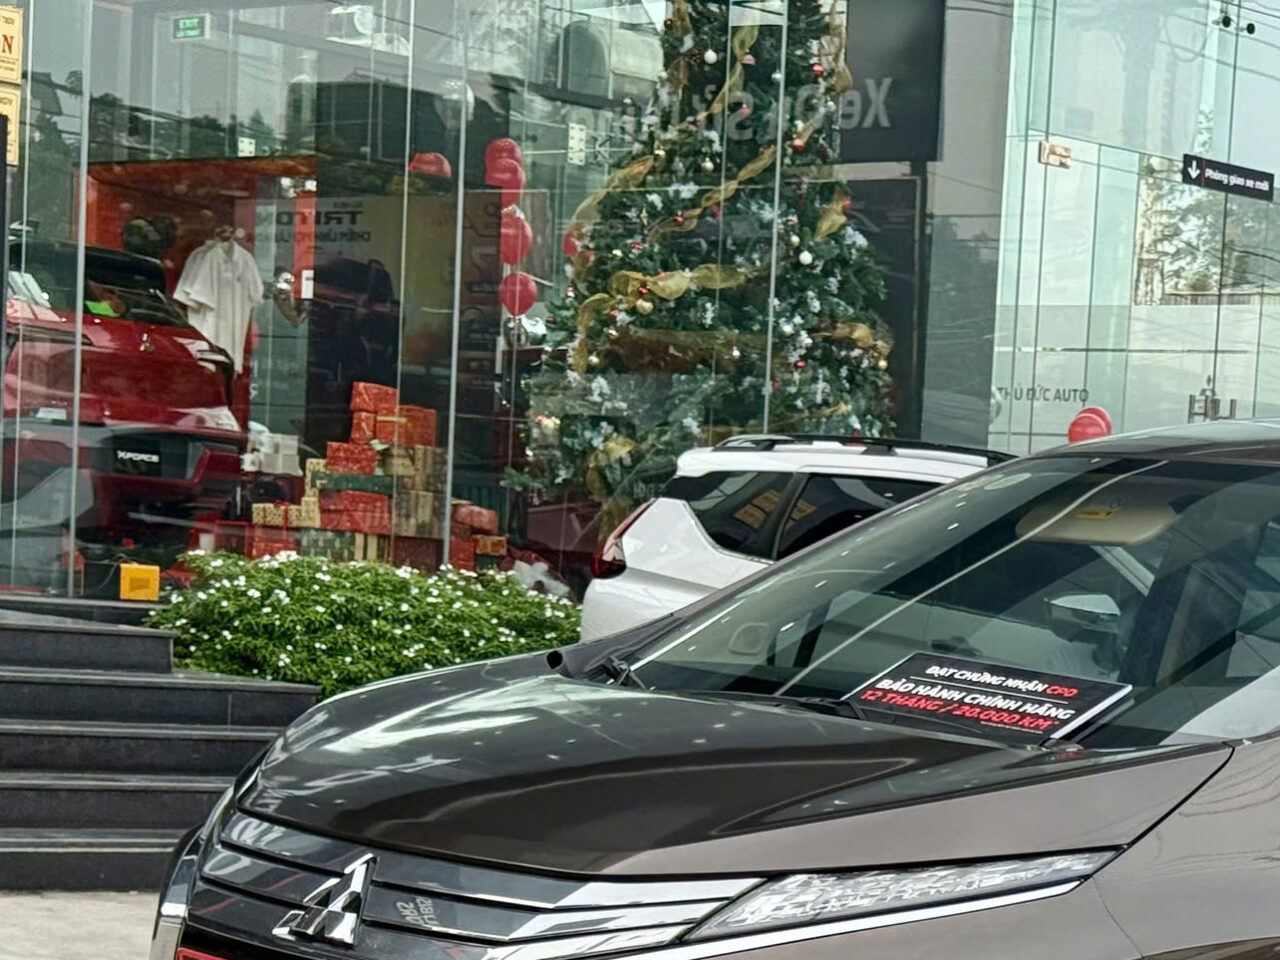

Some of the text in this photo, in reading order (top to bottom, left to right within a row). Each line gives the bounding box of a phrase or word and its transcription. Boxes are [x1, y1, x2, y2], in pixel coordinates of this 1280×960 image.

[1205, 168, 1229, 184] Phòng
[1054, 388, 1089, 402] AUTO
[925, 665, 958, 678] ĐẠT
[1002, 678, 1049, 692] NHẬN
[1045, 685, 1079, 698] CPO
[860, 690, 883, 701] 12
[881, 693, 944, 711] THÁNG
[938, 703, 959, 714] /
[952, 705, 1020, 724] 20.000
[875, 678, 915, 693] BẢO
[963, 694, 1023, 711] CHÍNH
[1018, 703, 1076, 719] HÃNG
